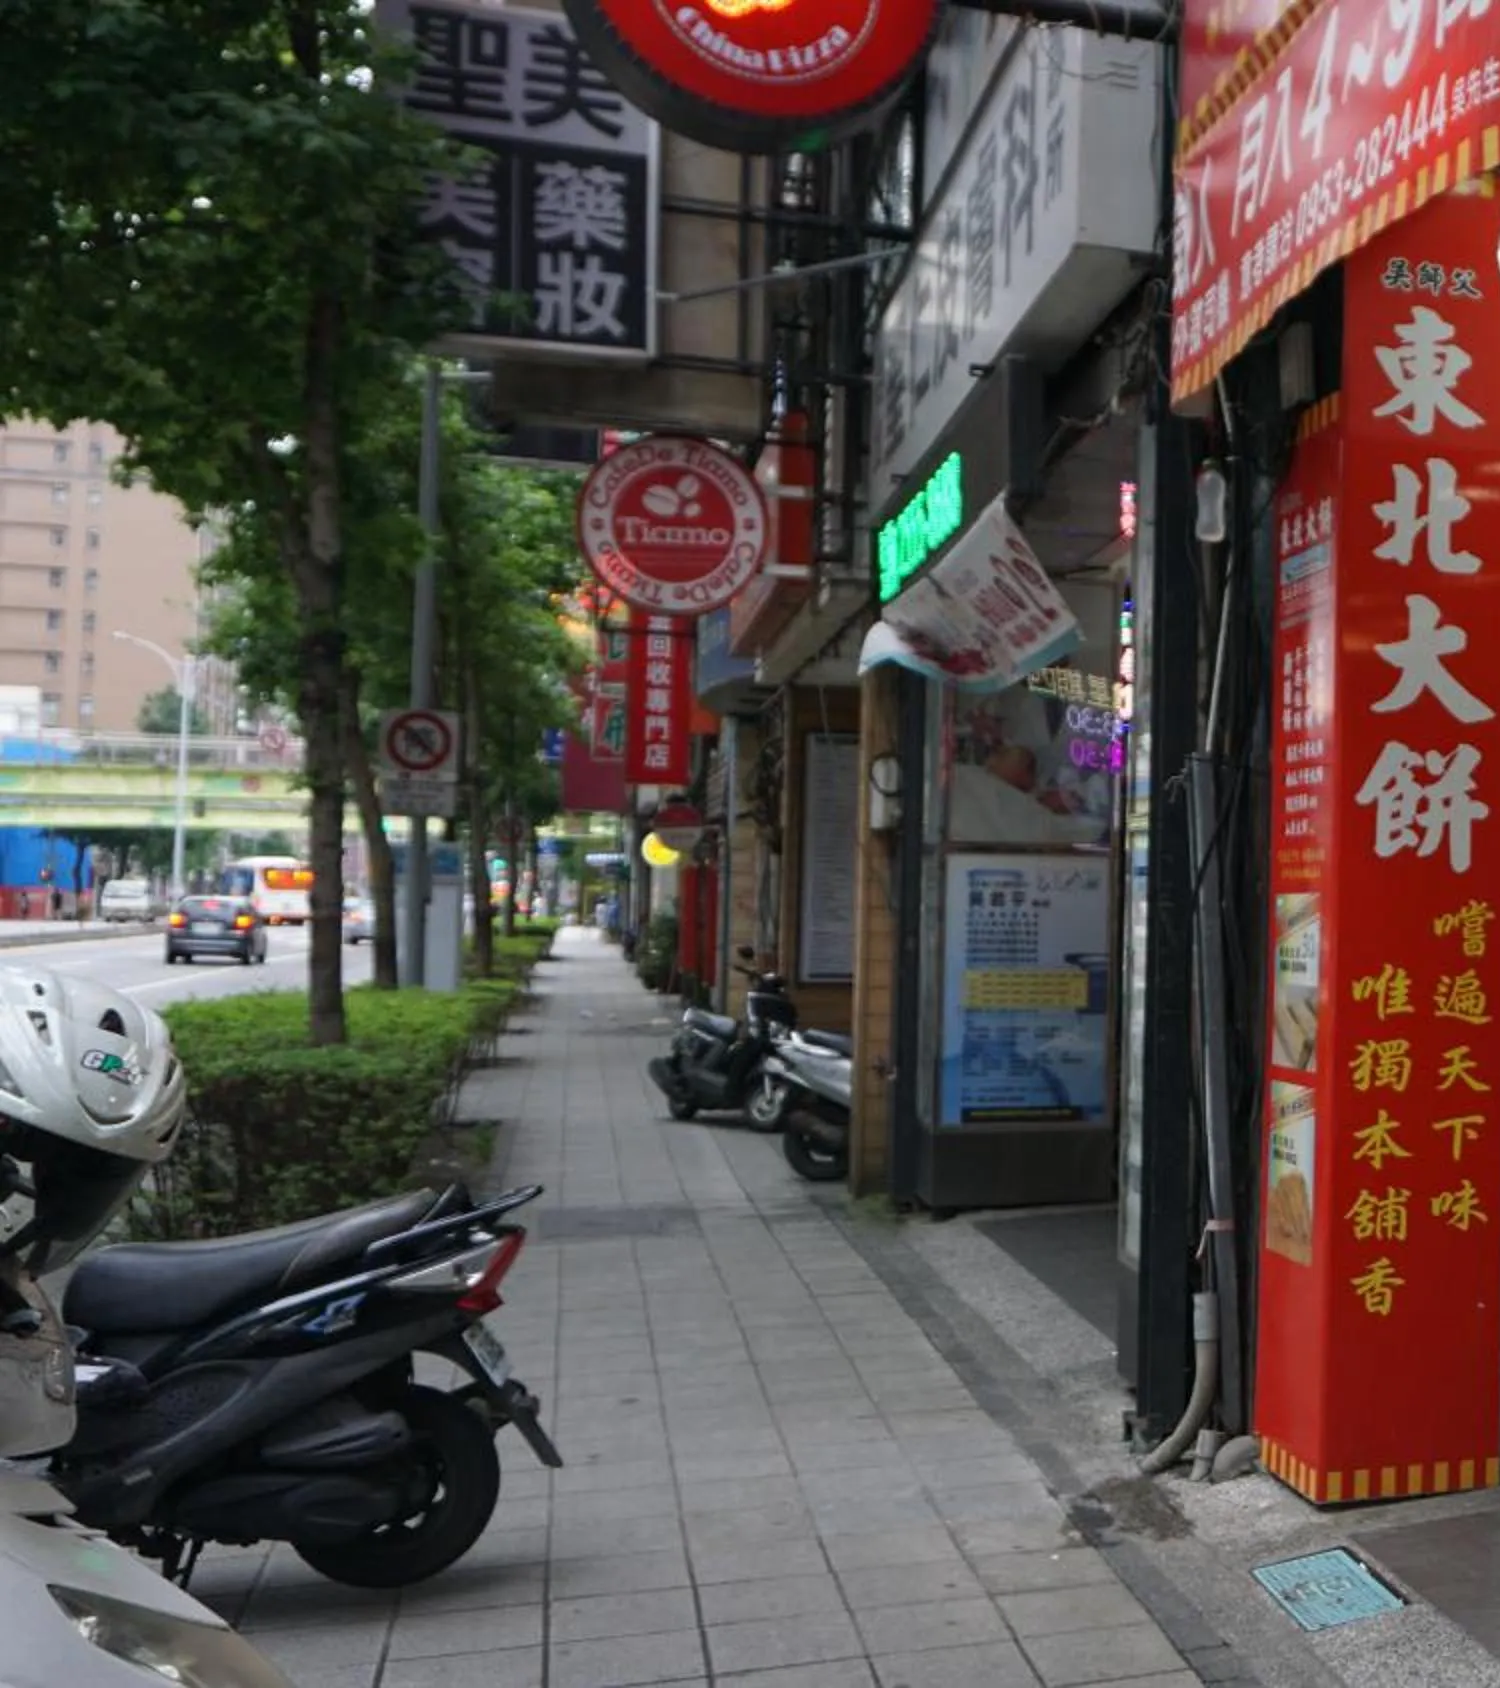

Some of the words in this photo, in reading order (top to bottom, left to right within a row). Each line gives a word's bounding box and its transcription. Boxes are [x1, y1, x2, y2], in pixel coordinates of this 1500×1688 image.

[534, 161, 628, 339] 藥妝
[1381, 257, 1484, 300] 吳師父
[1356, 304, 1495, 874] 東北大餅
